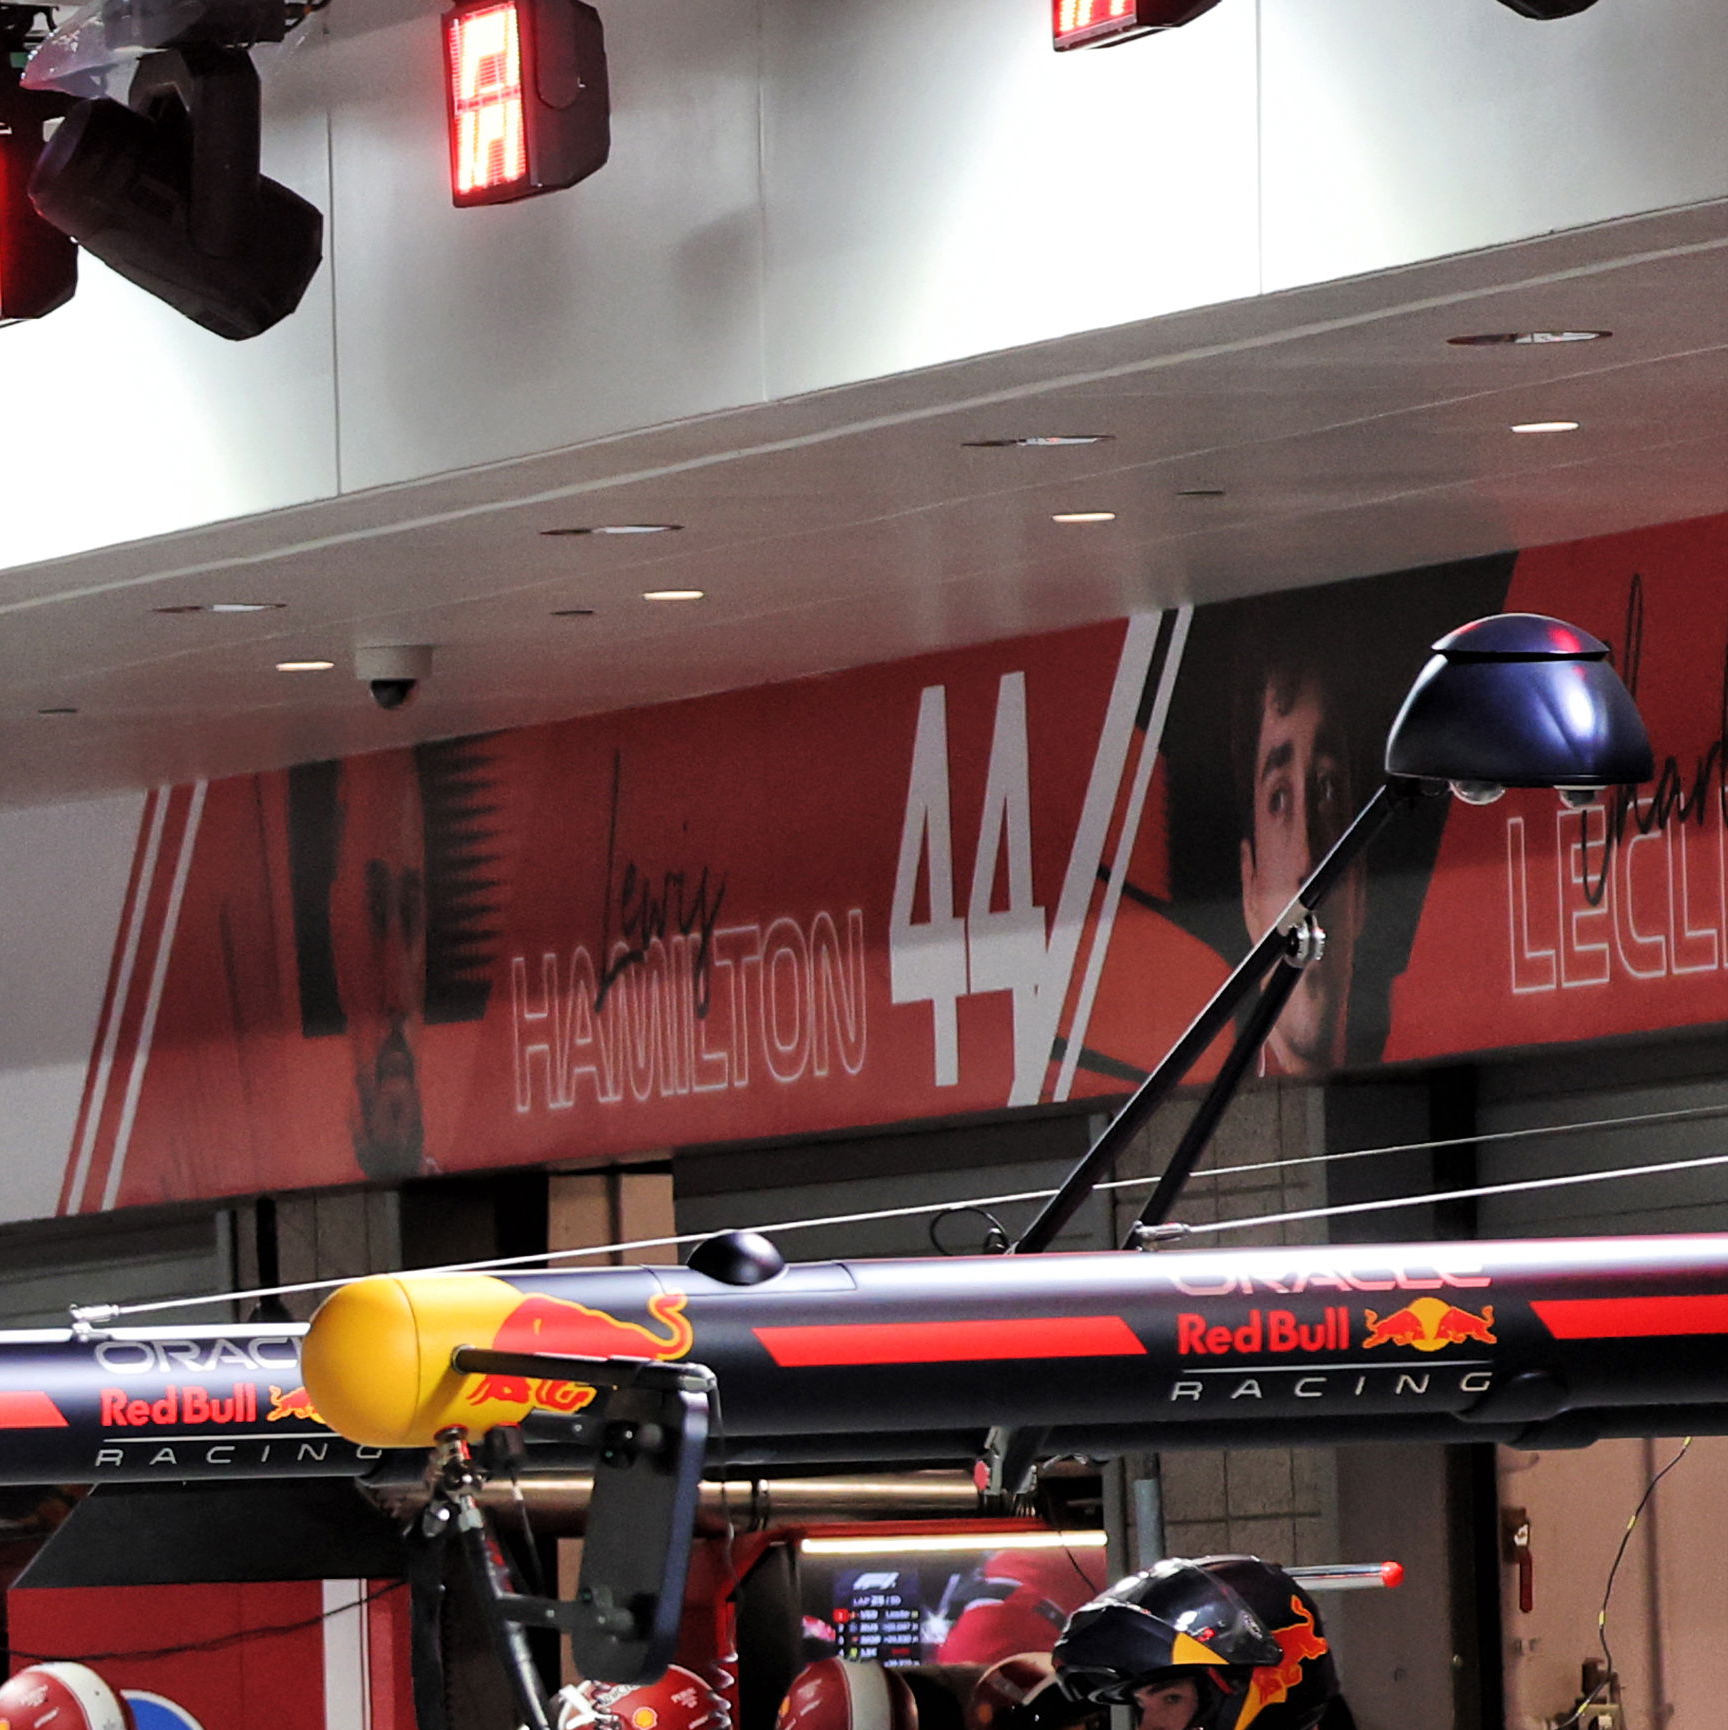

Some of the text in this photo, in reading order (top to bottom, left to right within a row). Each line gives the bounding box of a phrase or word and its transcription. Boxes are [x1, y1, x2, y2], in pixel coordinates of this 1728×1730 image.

[891, 671, 1046, 1108] 44
[1506, 789, 1728, 994] LECL
[512, 909, 867, 1112] HAMILTON
[1177, 1307, 1350, 1355] Red Bull
[95, 1337, 302, 1374] ORAC
[100, 1383, 256, 1427] Red Bull
[1171, 1372, 1492, 1401] RACING
